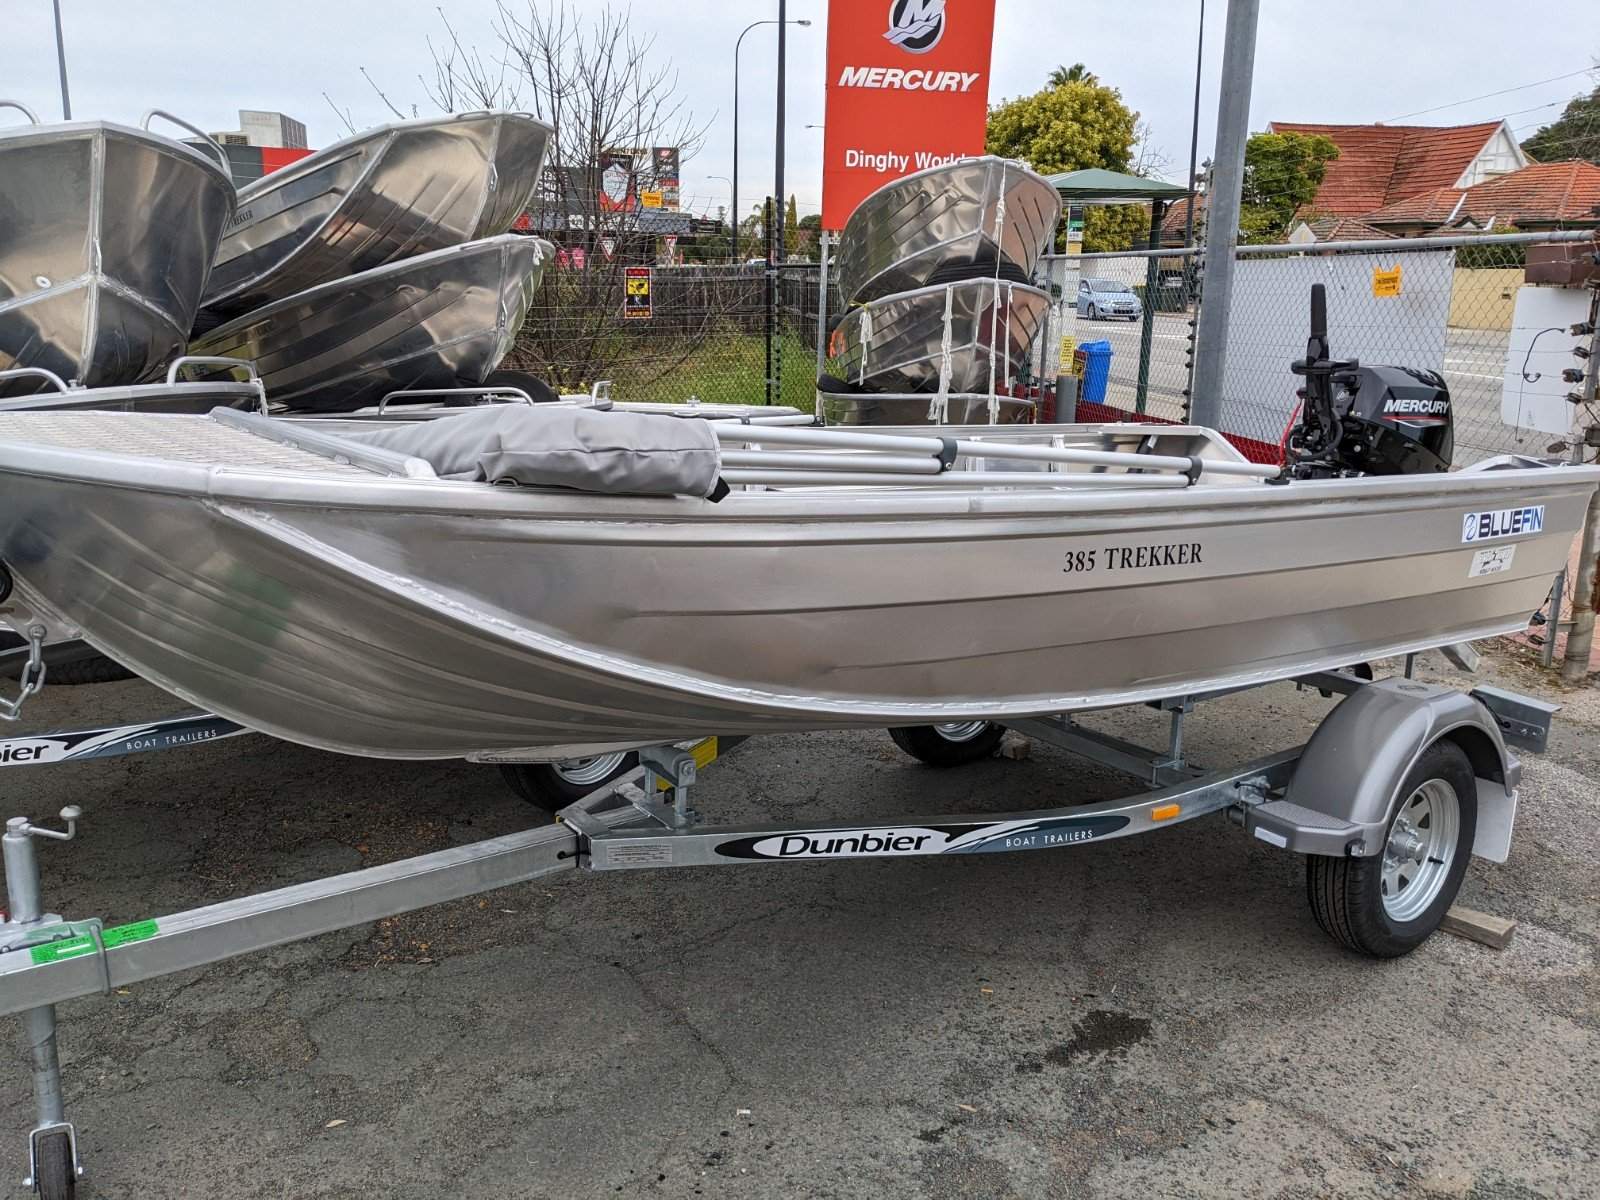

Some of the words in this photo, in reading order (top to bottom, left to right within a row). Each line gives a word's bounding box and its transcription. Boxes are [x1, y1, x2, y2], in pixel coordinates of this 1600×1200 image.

[838, 66, 980, 93] MERCURY
[845, 149, 909, 172] Dinghy
[1383, 399, 1450, 414] MERCURY
[1478, 507, 1544, 539] BLUEFIN
[1063, 549, 1097, 573] 385
[1103, 543, 1203, 570] TREKKER
[0, 744, 49, 763] ier
[126, 739, 157, 751] BOAT
[165, 729, 217, 746] TRAILERS
[778, 832, 931, 856] Dunbier
[1006, 836, 1036, 848] BOAT
[1043, 829, 1093, 845] TRAILERS
